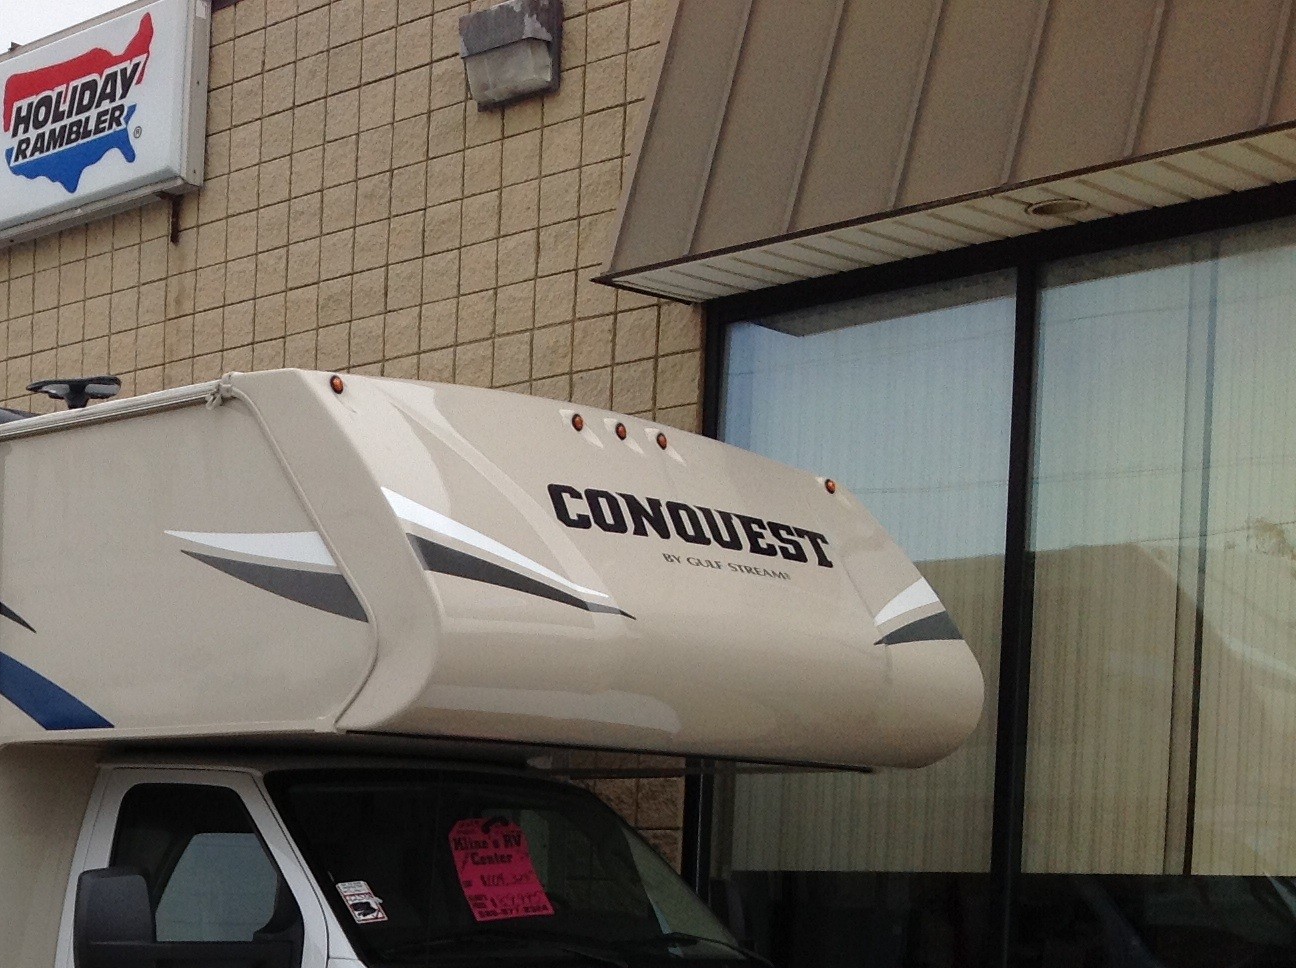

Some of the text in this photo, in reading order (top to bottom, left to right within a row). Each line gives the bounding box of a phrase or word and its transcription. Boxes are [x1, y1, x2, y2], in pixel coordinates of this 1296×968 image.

[11, 61, 141, 139] HOLIDAY
[13, 103, 126, 163] RAMBLER
[547, 483, 834, 569] CONQUEST
[662, 552, 682, 565] BY
[687, 556, 722, 570] GULF
